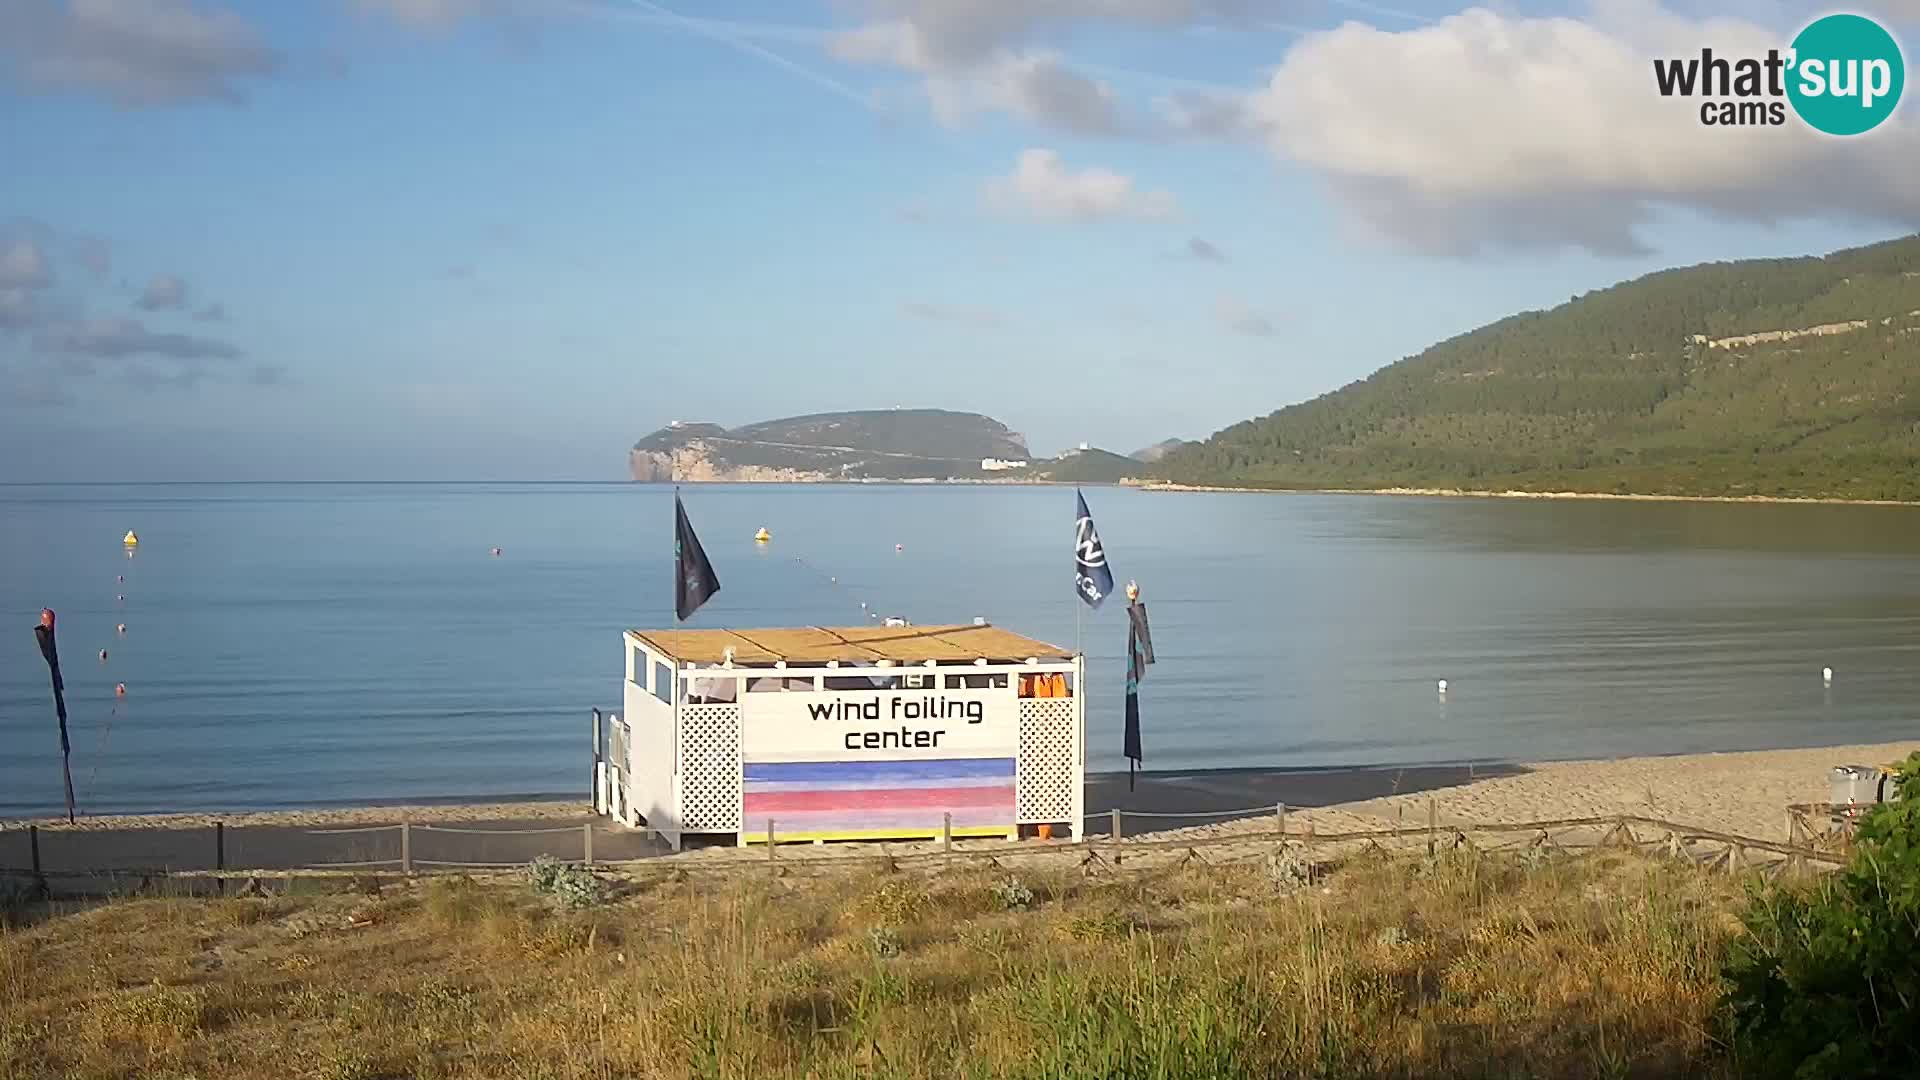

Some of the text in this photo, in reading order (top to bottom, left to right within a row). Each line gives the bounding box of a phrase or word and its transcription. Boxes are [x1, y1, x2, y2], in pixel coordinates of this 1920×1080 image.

[807, 696, 983, 724] wind foiling
[845, 727, 946, 750] center
